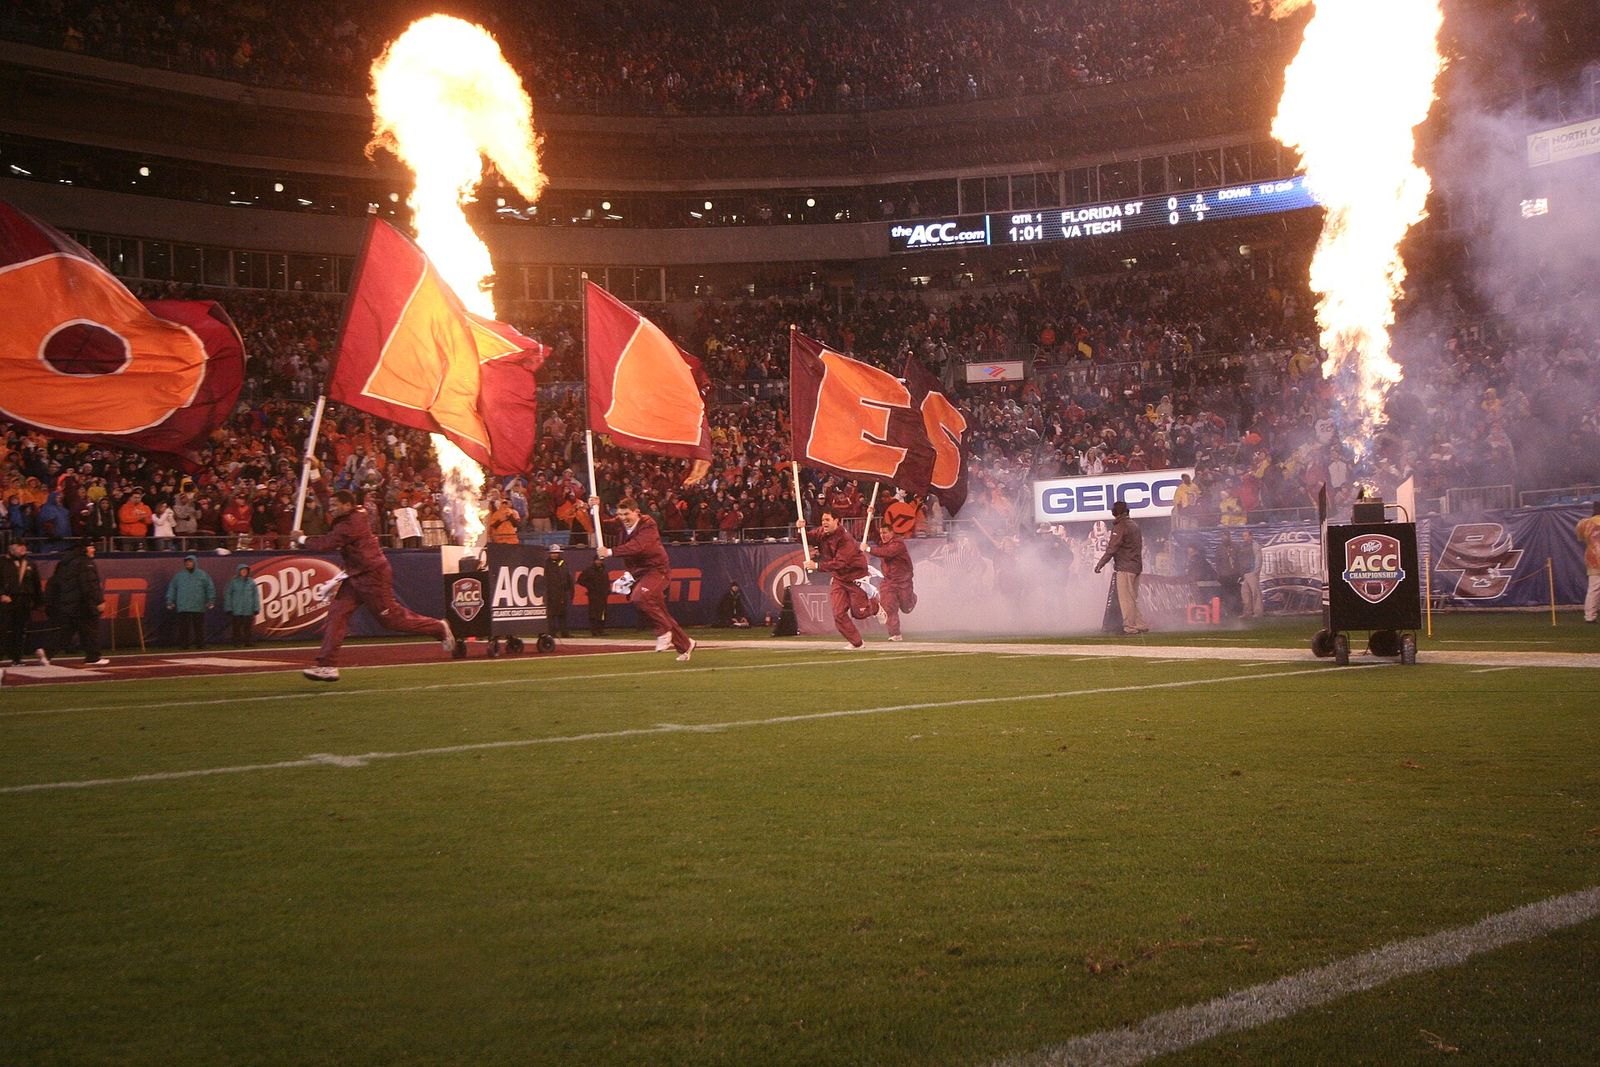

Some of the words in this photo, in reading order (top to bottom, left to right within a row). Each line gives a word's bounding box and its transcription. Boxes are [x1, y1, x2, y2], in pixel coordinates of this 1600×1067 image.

[1218, 187, 1252, 200] DOWN
[1259, 184, 1274, 195] TO
[1061, 205, 1122, 223] FLORIDA
[1124, 202, 1144, 216] ST
[1167, 197, 1177, 210] 0
[1011, 214, 1033, 224] QTR
[1036, 213, 1042, 222] 1
[1169, 211, 1179, 225] 0
[1009, 225, 1043, 242] 1:01
[1061, 226, 1081, 239] VA
[1083, 219, 1122, 236] TECH
[1041, 478, 1184, 515] GEICO
[1350, 554, 1397, 572] ACC
[278, 566, 316, 597] Dr
[492, 566, 544, 607] ACC
[254, 574, 328, 626] Peppe
[456, 590, 480, 602] ACC
